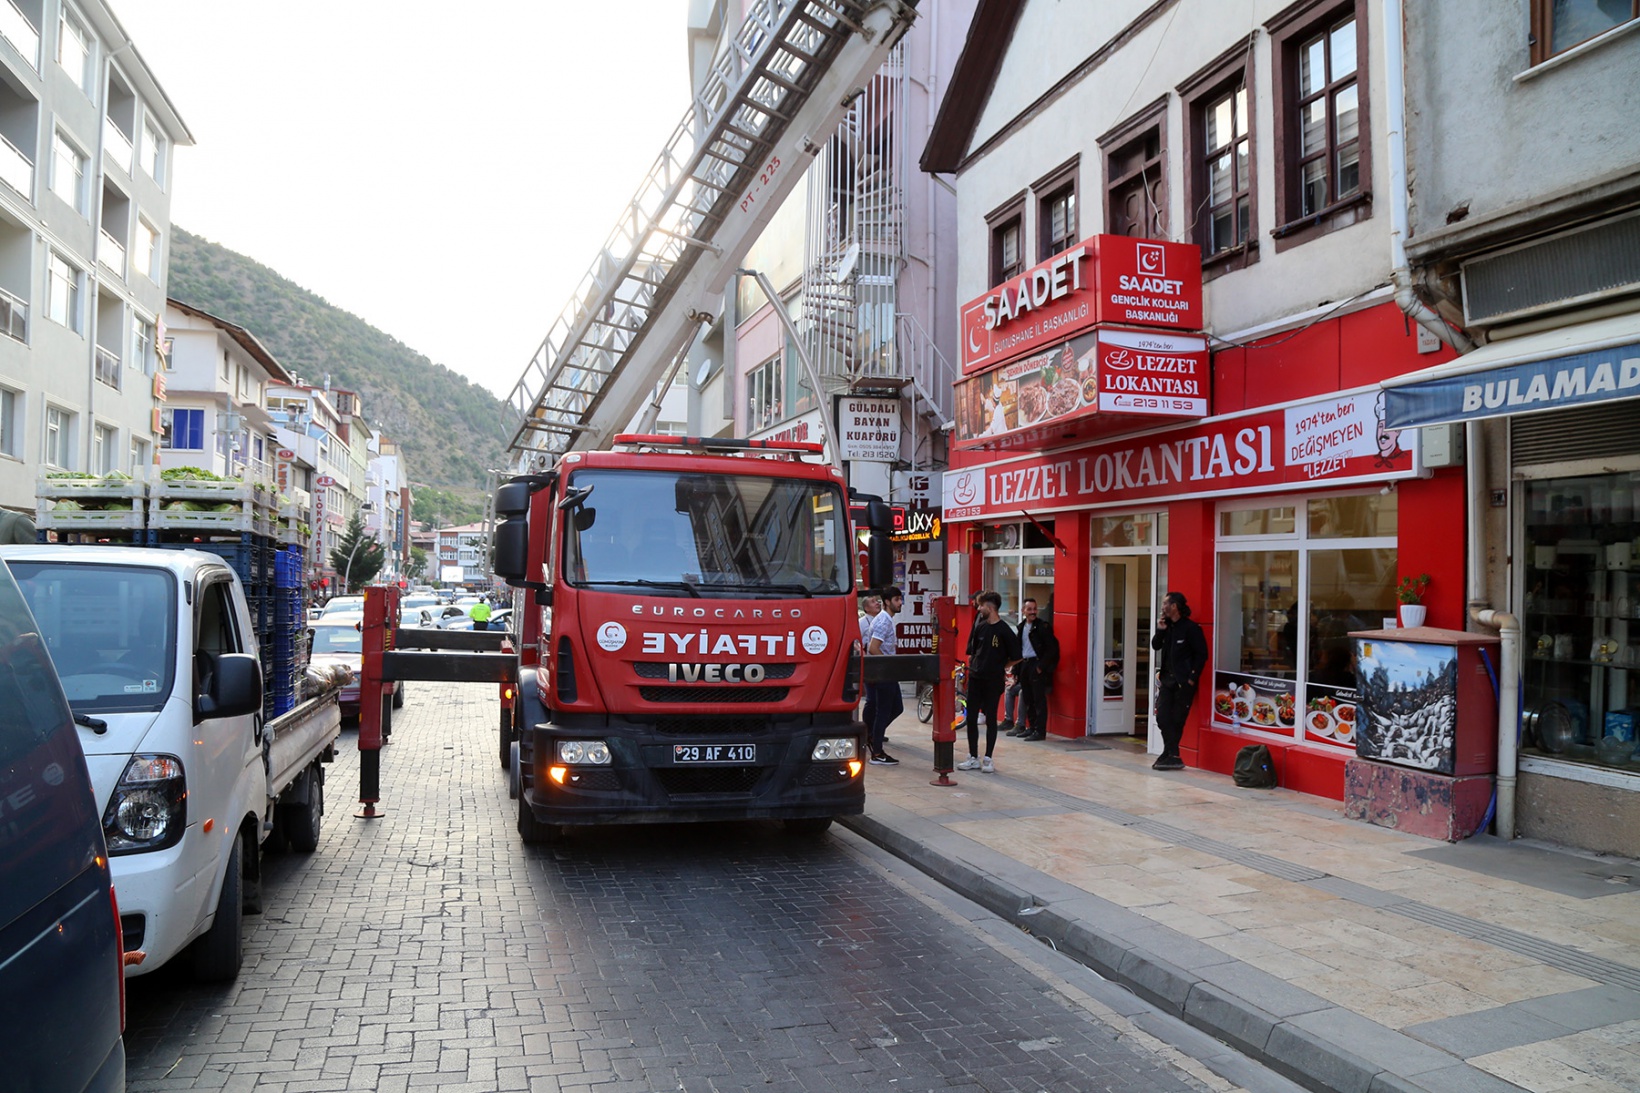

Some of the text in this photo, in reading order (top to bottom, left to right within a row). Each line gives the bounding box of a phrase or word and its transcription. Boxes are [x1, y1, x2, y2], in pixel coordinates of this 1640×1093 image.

[760, 155, 781, 186] 223
[984, 246, 1086, 331] SAADET
[1119, 275, 1184, 295] SAADET
[1111, 294, 1189, 310] GENÇLİK KOLLARI
[1125, 310, 1179, 323] BAŞKANLIĞI
[1136, 355, 1197, 374] LEZZET
[1105, 374, 1199, 395] LOKANTASI
[1462, 357, 1640, 412] BULAMAD
[849, 401, 895, 413] GÜLDALI
[1133, 398, 1158, 408] 213
[1161, 399, 1169, 408] 11
[1172, 400, 1193, 410] 53
[854, 417, 890, 427] BAYAN
[1295, 398, 1355, 435] 1974'ten beri
[846, 430, 896, 442] KUAFÖRÜ
[1291, 421, 1363, 461] DEĞİŞMEYEN
[876, 451, 895, 459] 1520
[989, 425, 1275, 506] LEZZET LOKANTASI
[632, 604, 802, 619] EUROCARGO
[903, 625, 933, 635] BAYAN
[668, 663, 765, 683] IVECO
[682, 746, 753, 761] 29 AF 410
